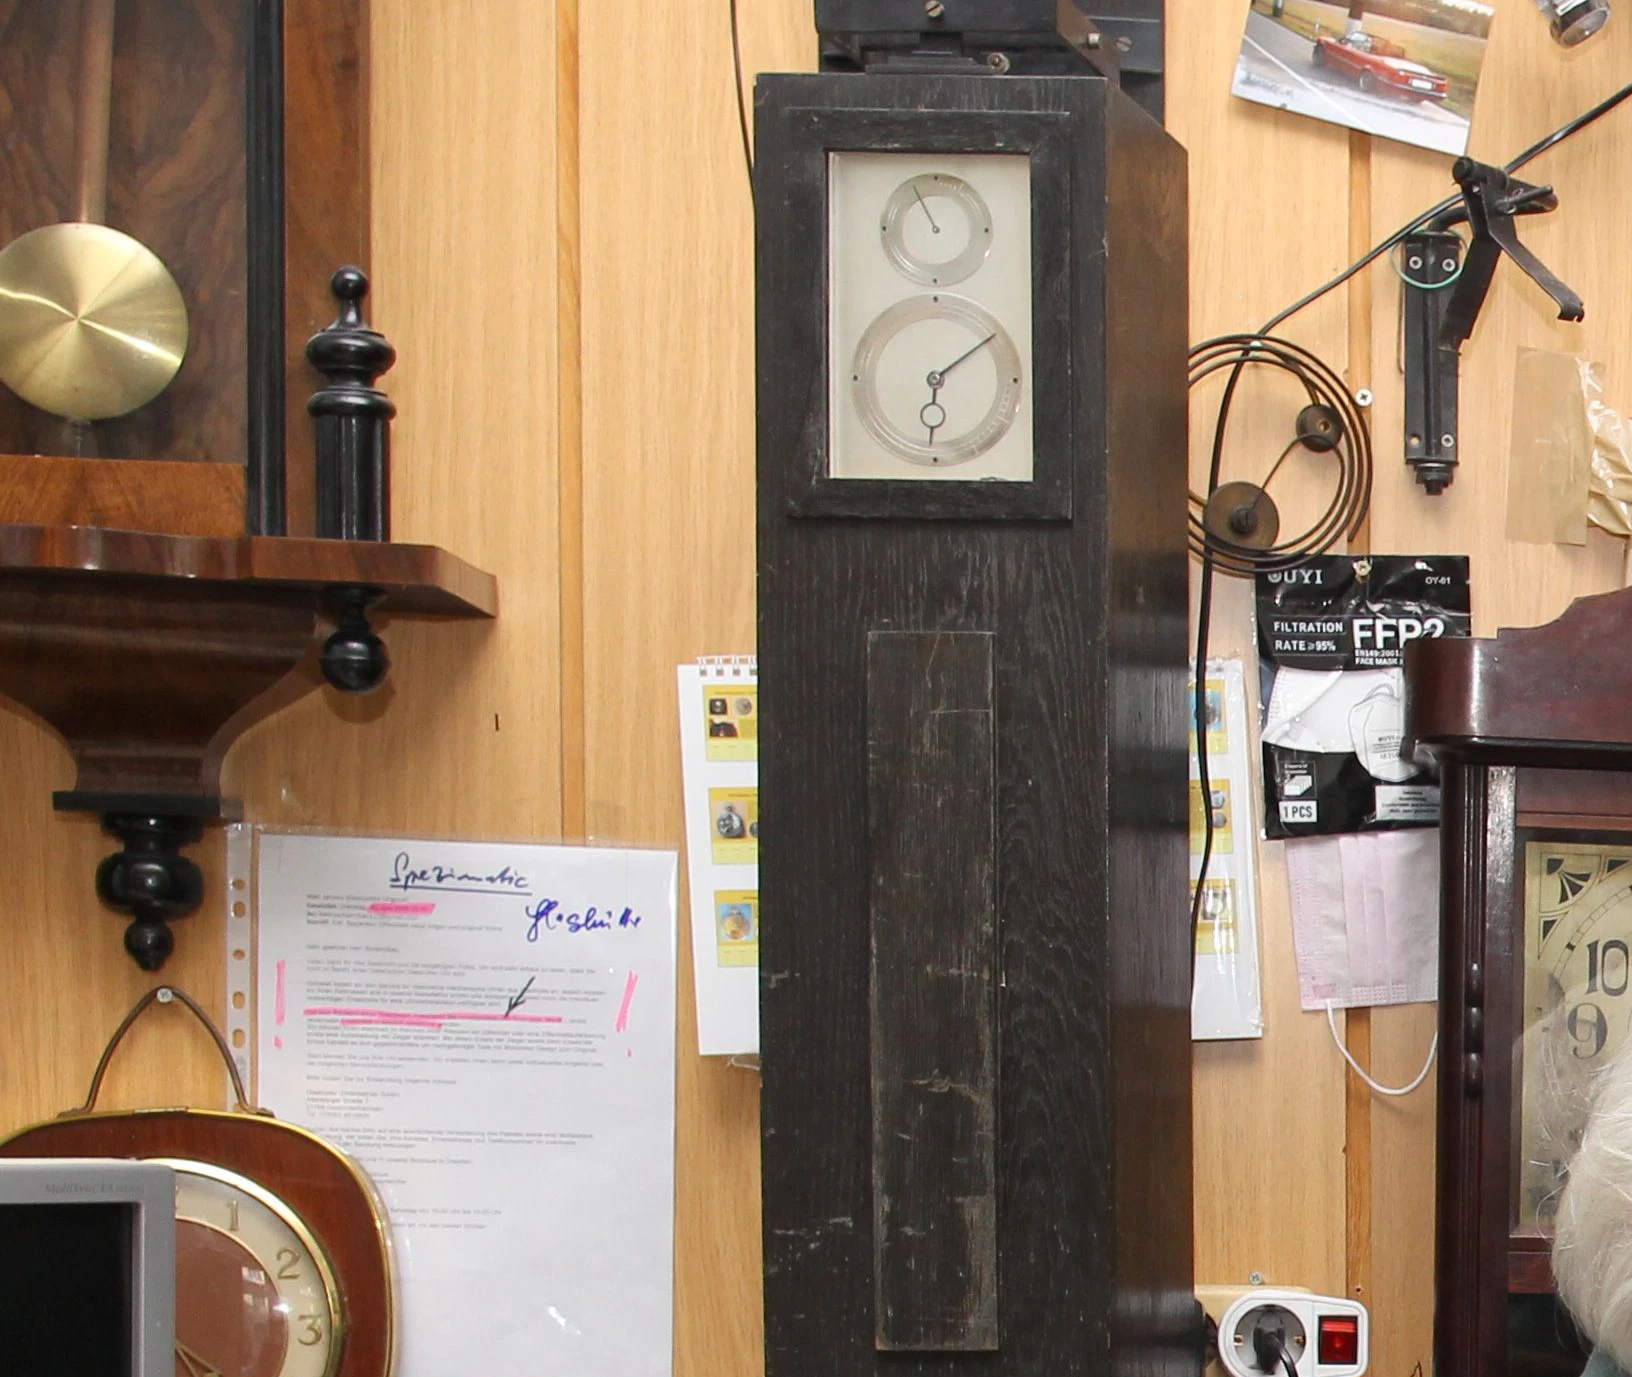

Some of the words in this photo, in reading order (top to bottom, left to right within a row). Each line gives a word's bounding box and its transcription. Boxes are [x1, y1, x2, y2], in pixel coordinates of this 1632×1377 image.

[1273, 621, 1344, 634] FILTRATION
[1275, 638, 1307, 651] RATE
[1355, 657, 1374, 666] FACE
[1375, 657, 1399, 666] MASK
[1283, 806, 1289, 818] 1
[1291, 805, 1313, 818] PCS
[1585, 938, 1630, 997] 10
[1567, 1001, 1608, 1060] 9
[226, 1199, 239, 1232] 1
[275, 1248, 301, 1280] 2
[297, 1314, 322, 1346] 3
